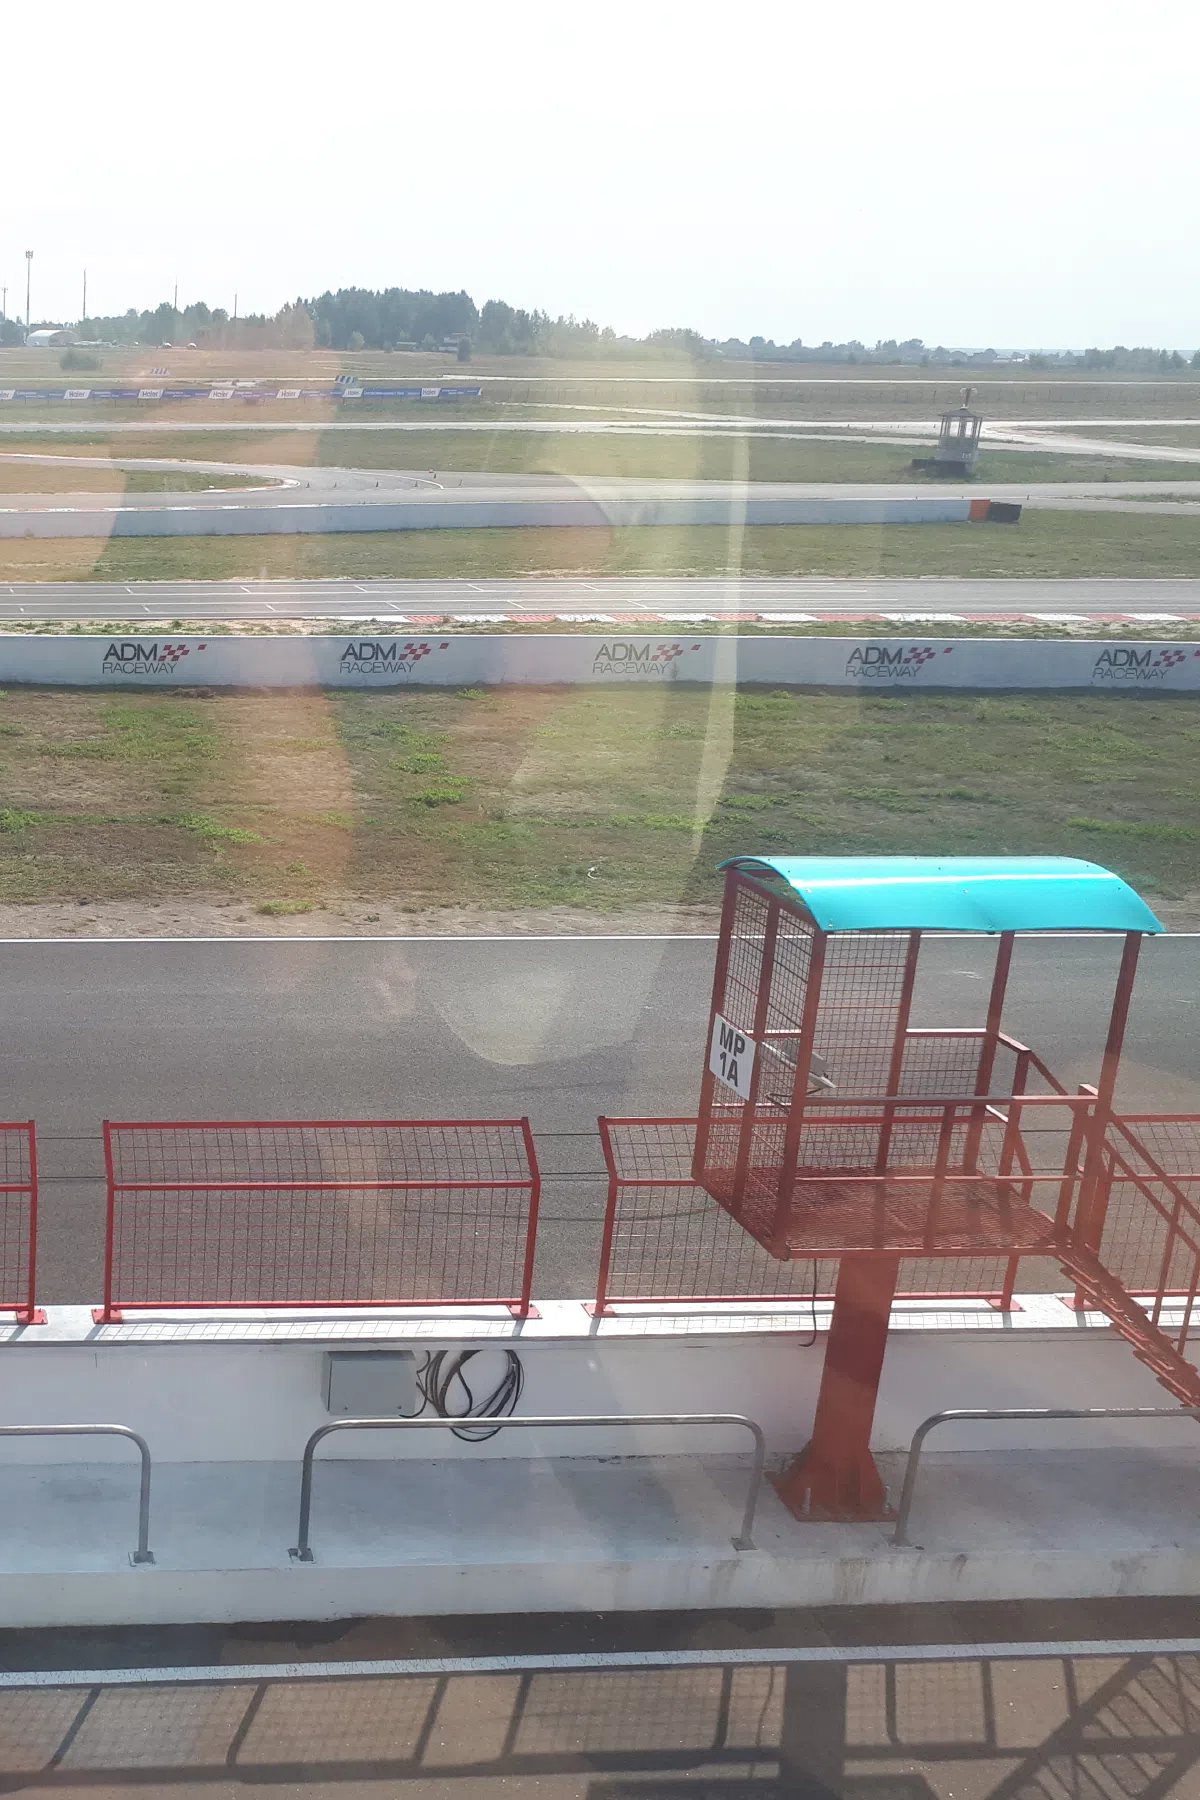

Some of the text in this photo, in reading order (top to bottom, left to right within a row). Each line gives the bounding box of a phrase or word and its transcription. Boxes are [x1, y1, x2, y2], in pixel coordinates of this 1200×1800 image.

[69, 390, 86, 398] Haier
[142, 390, 158, 398] Haier
[213, 390, 229, 398] Haier
[103, 643, 158, 662] ADM
[341, 642, 397, 661] ADM
[594, 643, 650, 662] ADM
[847, 647, 903, 665] ADM
[1095, 649, 1152, 667] ADM
[102, 661, 178, 674] RACEWAY
[339, 661, 416, 674] RACEWAY
[592, 661, 670, 674] RACEWAY
[845, 665, 922, 678] RACEWAY
[1092, 667, 1169, 680] RACEWAY
[719, 1022, 746, 1057] MP
[719, 1051, 739, 1087] 1A
